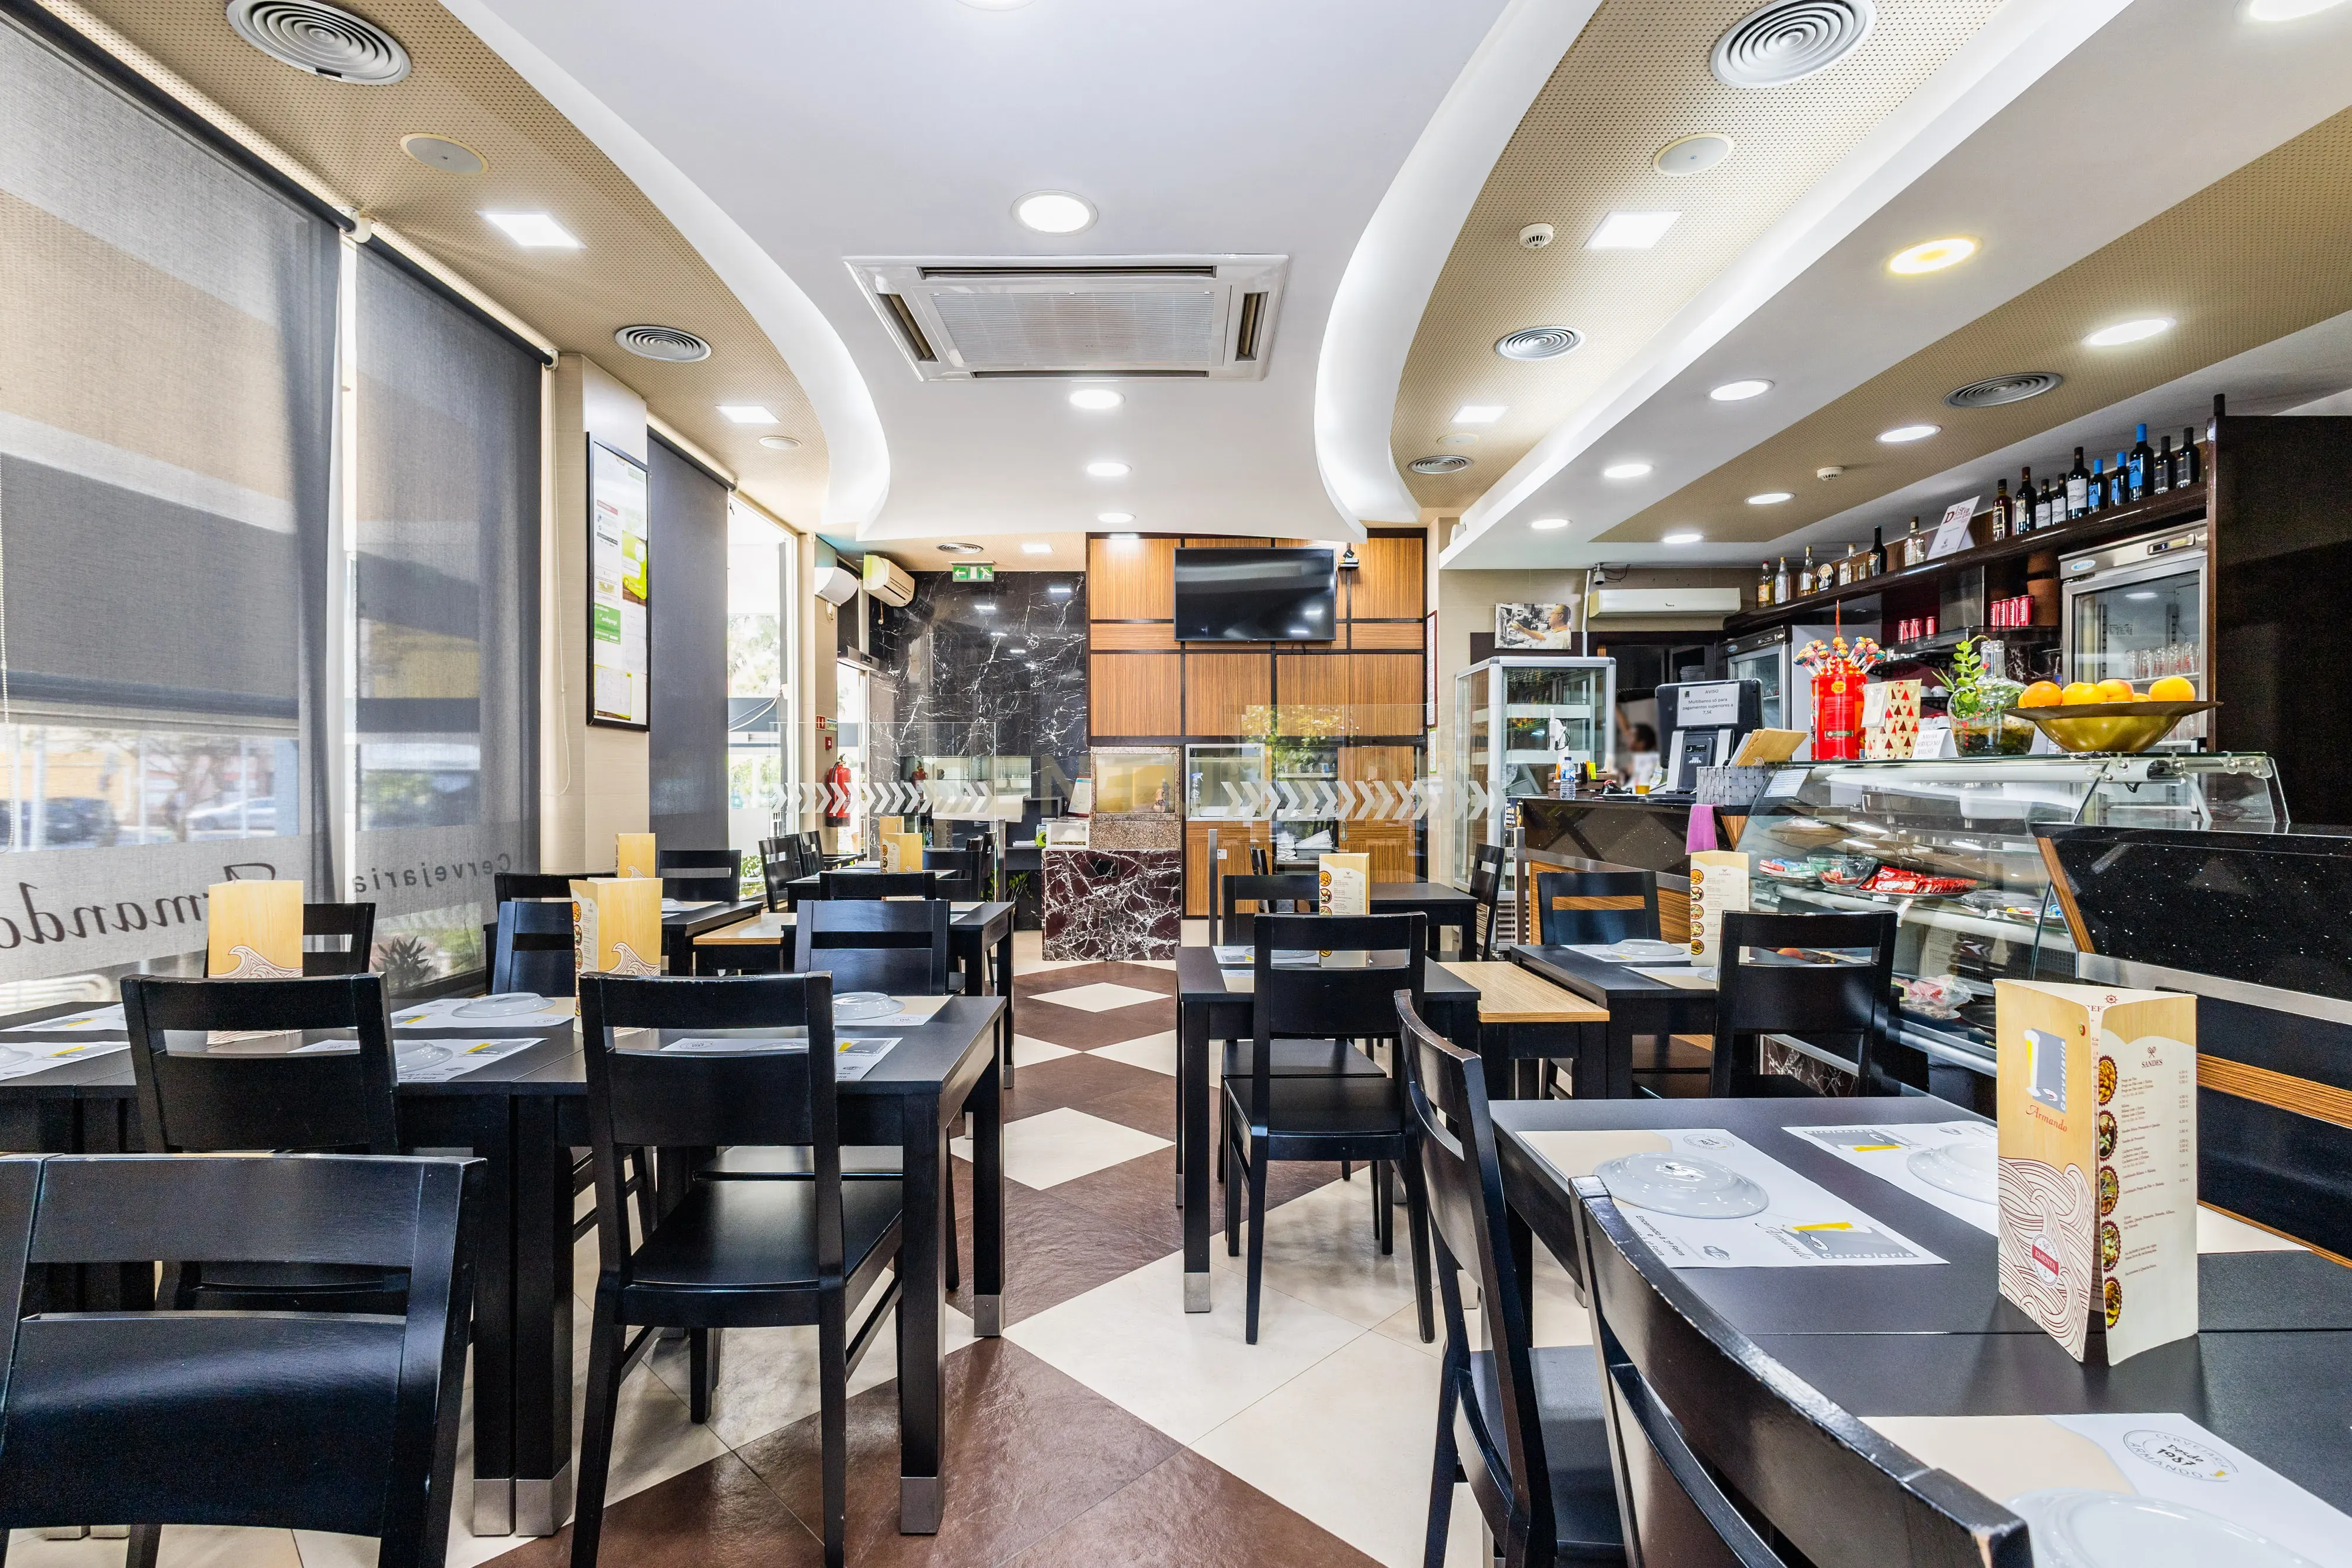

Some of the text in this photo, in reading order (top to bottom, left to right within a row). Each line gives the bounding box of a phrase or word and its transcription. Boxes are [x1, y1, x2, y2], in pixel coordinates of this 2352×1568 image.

[2141, 1059, 2163, 1068] SANDES
[2025, 1105, 2067, 1132] Armando
[1636, 1215, 1662, 1236] Encerrado
[1669, 1245, 1685, 1256] Feira
[1649, 1245, 1665, 1256] Feira
[2035, 1249, 2056, 1271] EMENTA
[2130, 1442, 2203, 1478] ARMANDO
[2156, 1434, 2229, 1468] CERVEJARIA
[2156, 1448, 2196, 1466] 1987
[2167, 1444, 2204, 1462] Desde
